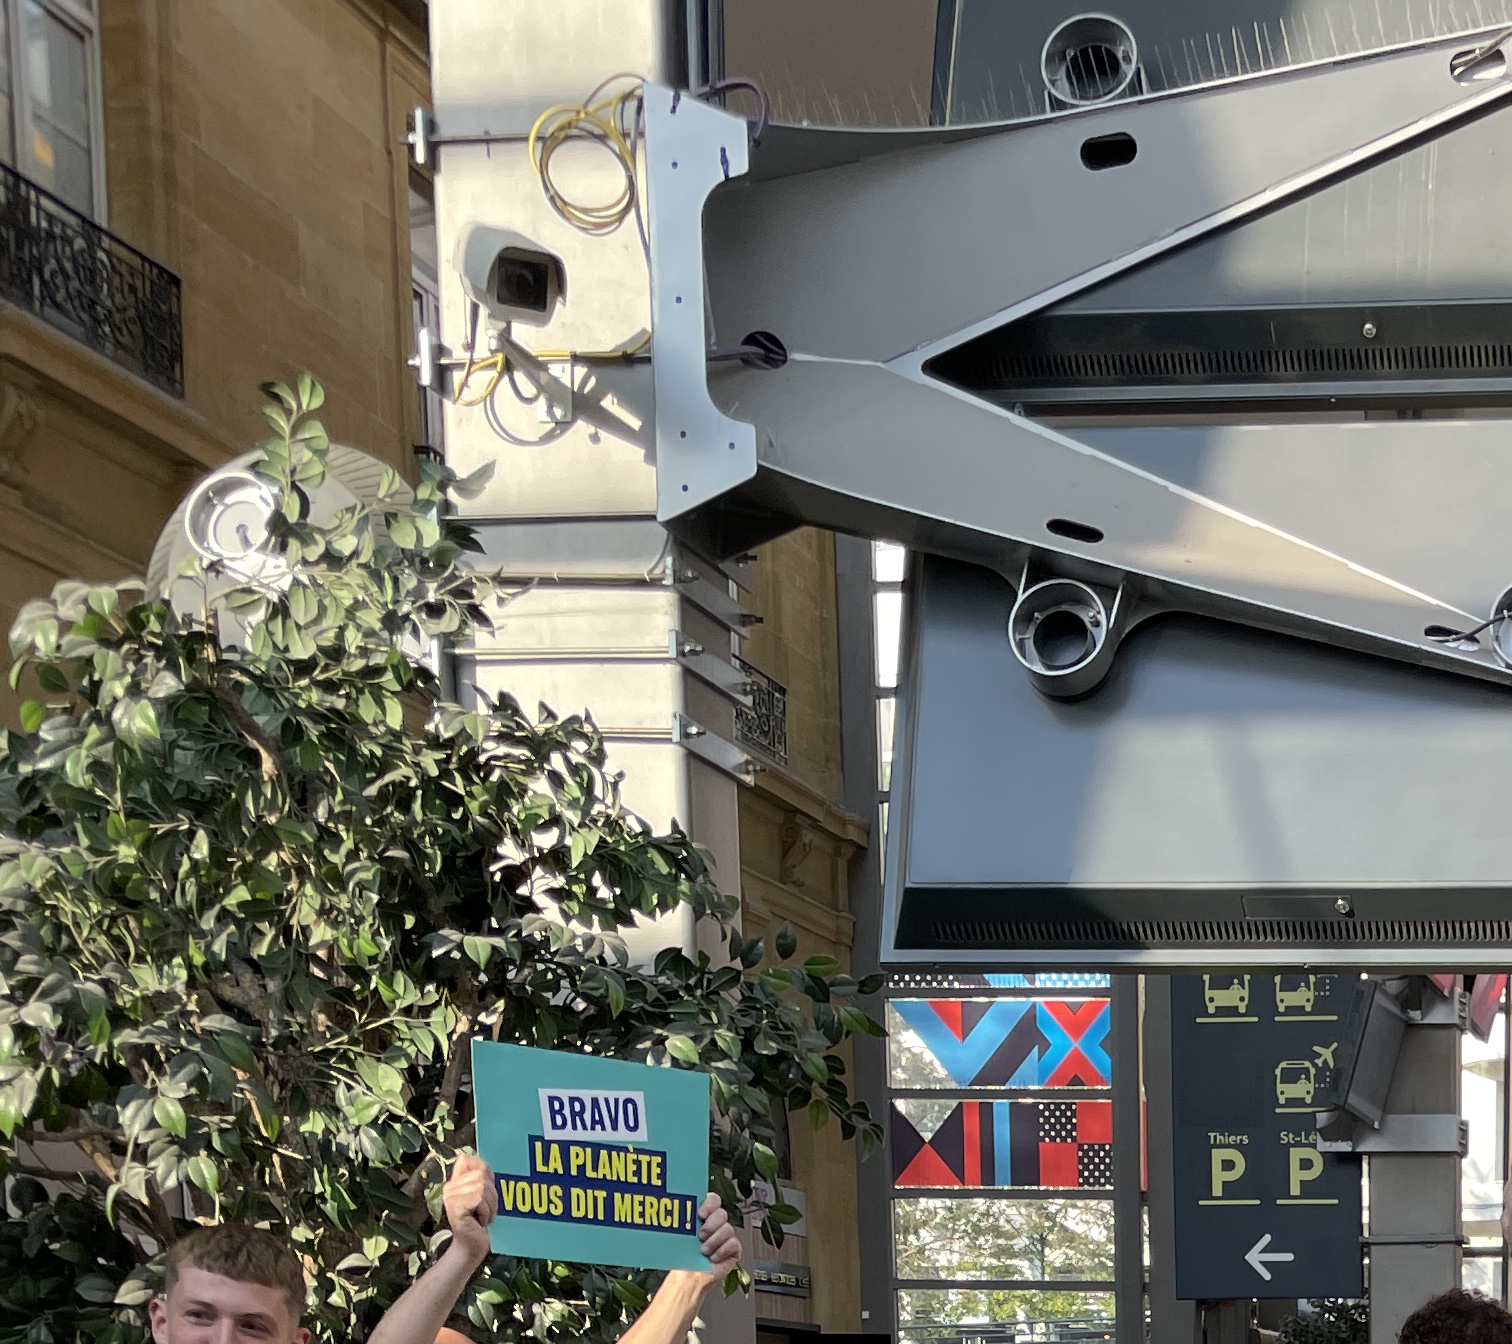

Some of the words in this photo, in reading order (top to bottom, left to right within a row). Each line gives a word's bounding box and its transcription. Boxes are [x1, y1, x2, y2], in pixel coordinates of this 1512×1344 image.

[547, 1095, 640, 1133] BRAVO
[1207, 1131, 1249, 1145] Thiers
[534, 1141, 564, 1175] LA
[569, 1143, 662, 1187] PLANÈTE
[1211, 1147, 1246, 1197] P
[1289, 1146, 1324, 1196] P
[499, 1178, 563, 1217] VOUS
[570, 1186, 607, 1221] DIT
[614, 1191, 680, 1230] MERCI
